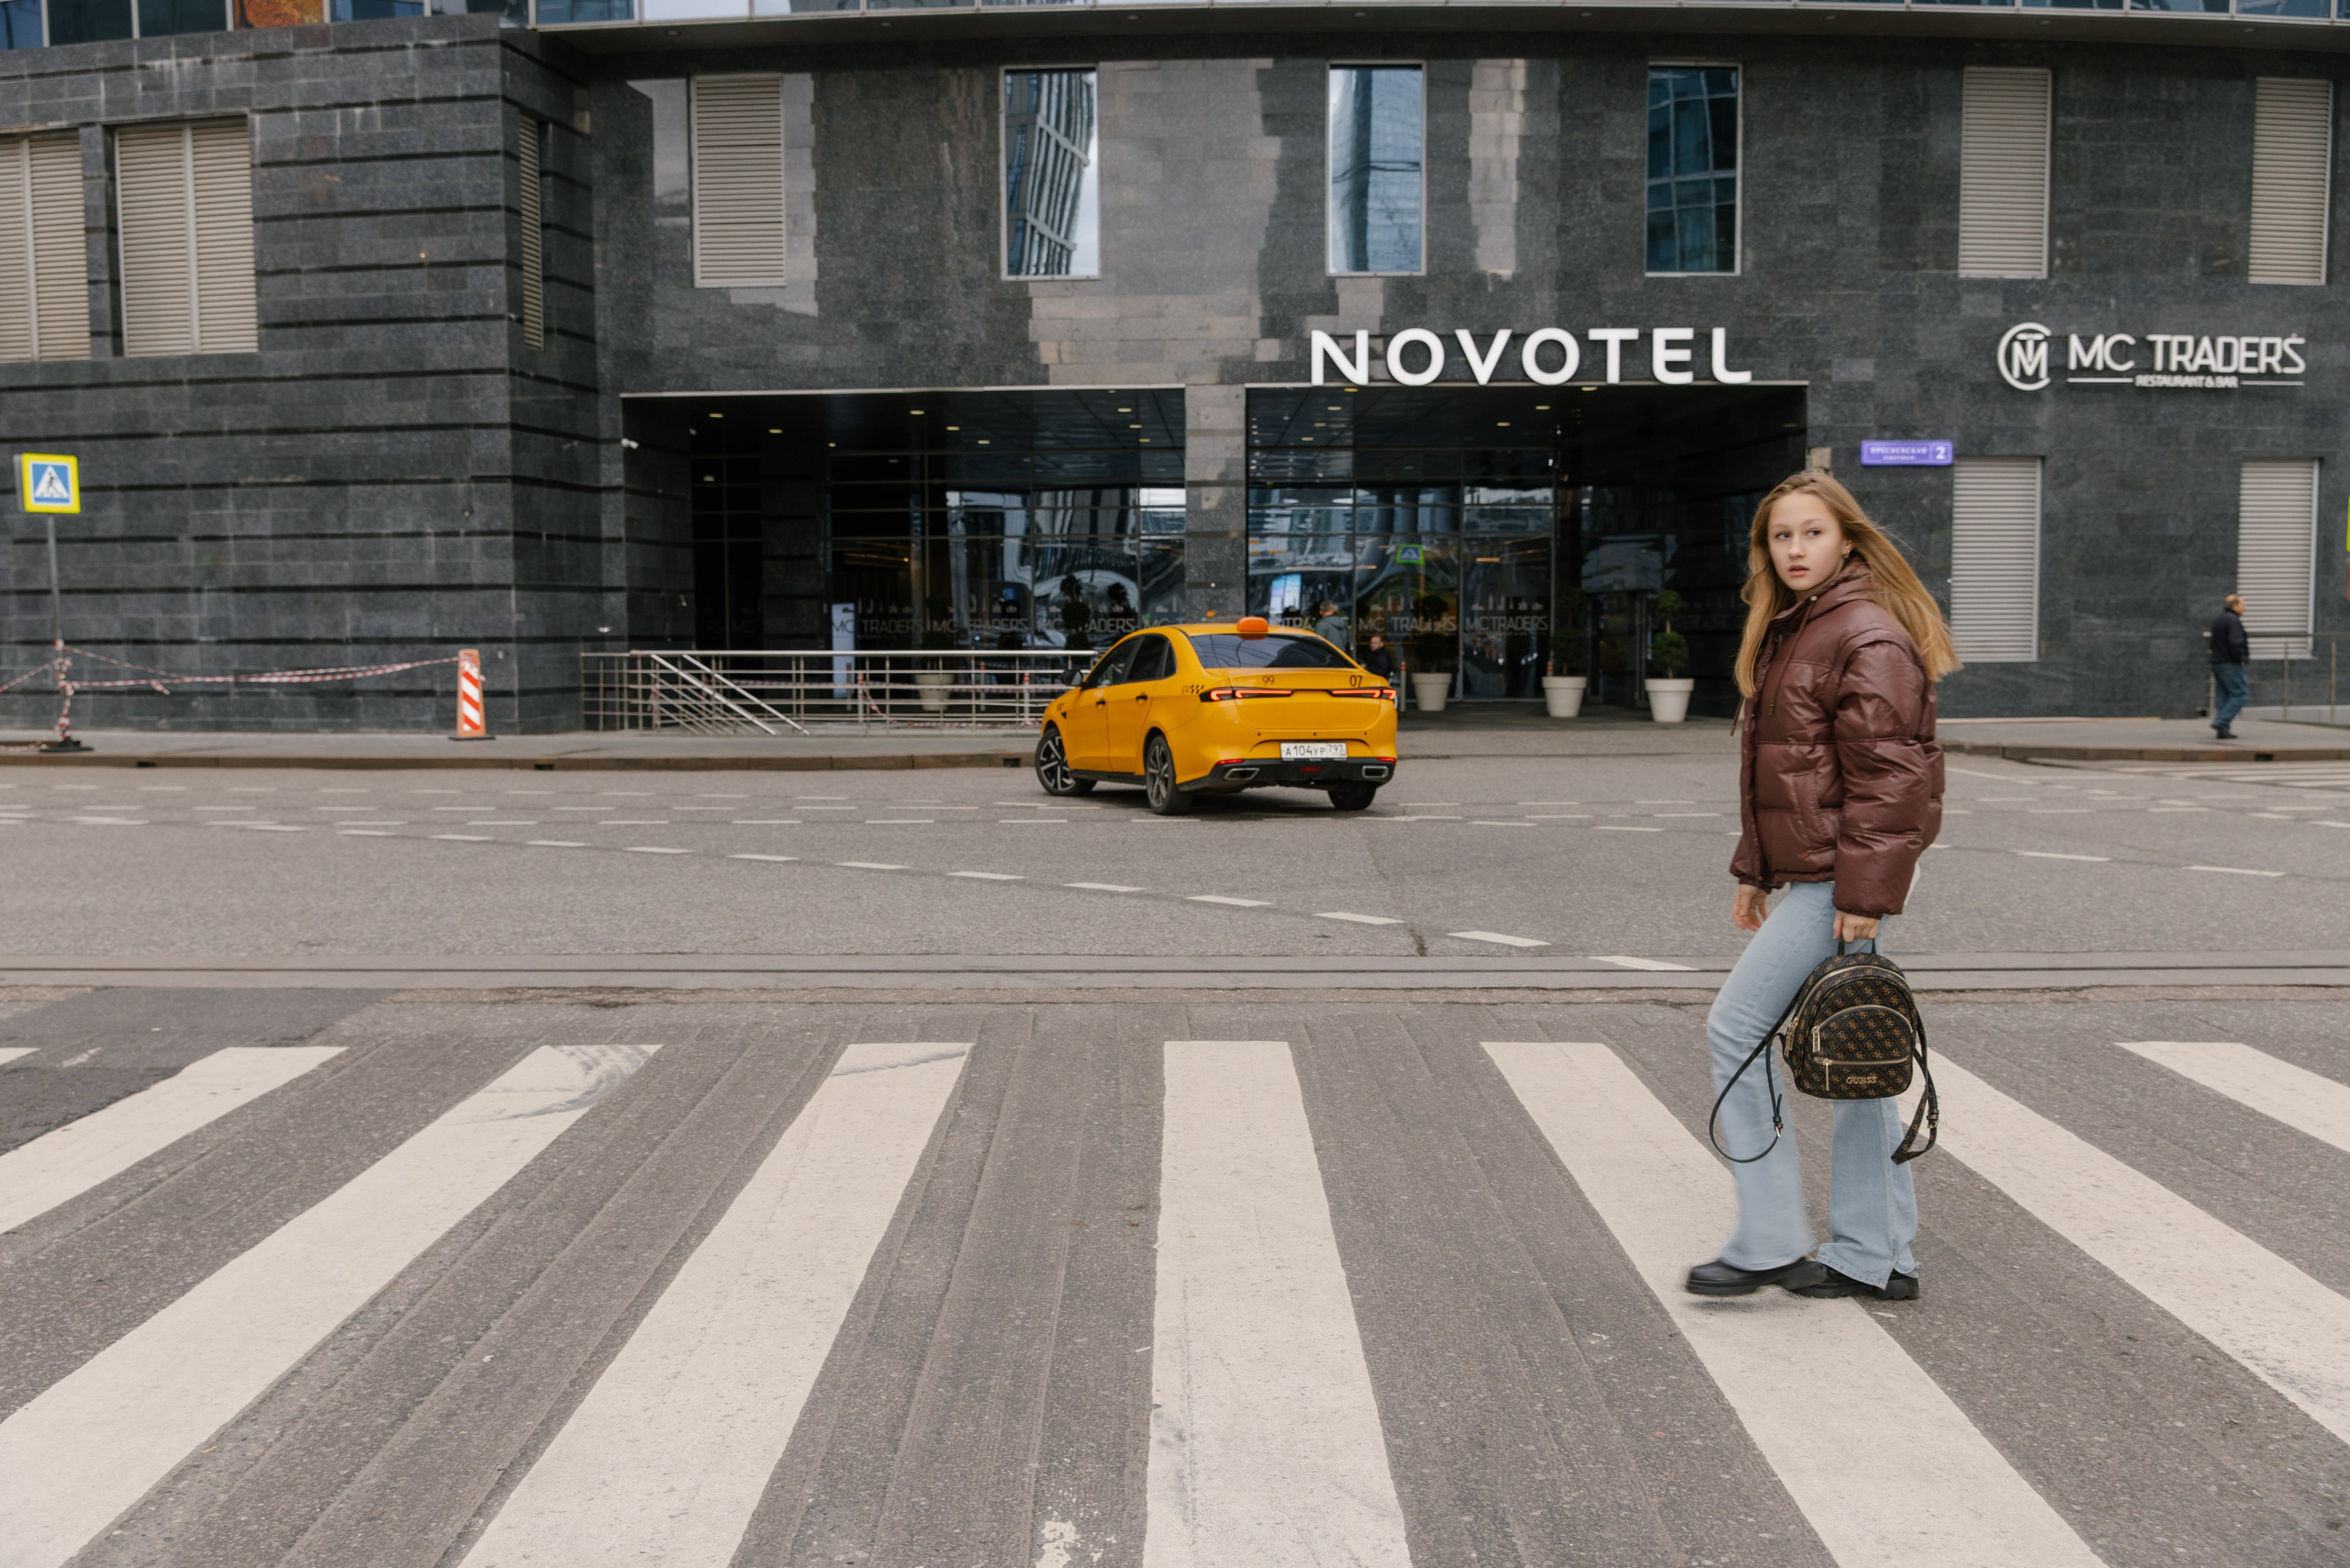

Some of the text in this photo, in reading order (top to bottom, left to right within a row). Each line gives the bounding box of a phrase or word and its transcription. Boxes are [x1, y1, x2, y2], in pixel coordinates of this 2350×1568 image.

[1310, 326, 1752, 386] NOVOTEL
[2067, 332, 2307, 375] MC TRADERS
[2134, 374, 2205, 387] RESTAURANT
[2215, 375, 2239, 388] BAR
[1935, 445, 1946, 459] 2
[861, 618, 924, 634] TRADERS
[1359, 616, 1385, 632] MC
[1464, 615, 1549, 632] MC TRADERS
[1262, 675, 1275, 686] 99
[1349, 674, 1363, 688] 07
[1327, 744, 1342, 753] 797
